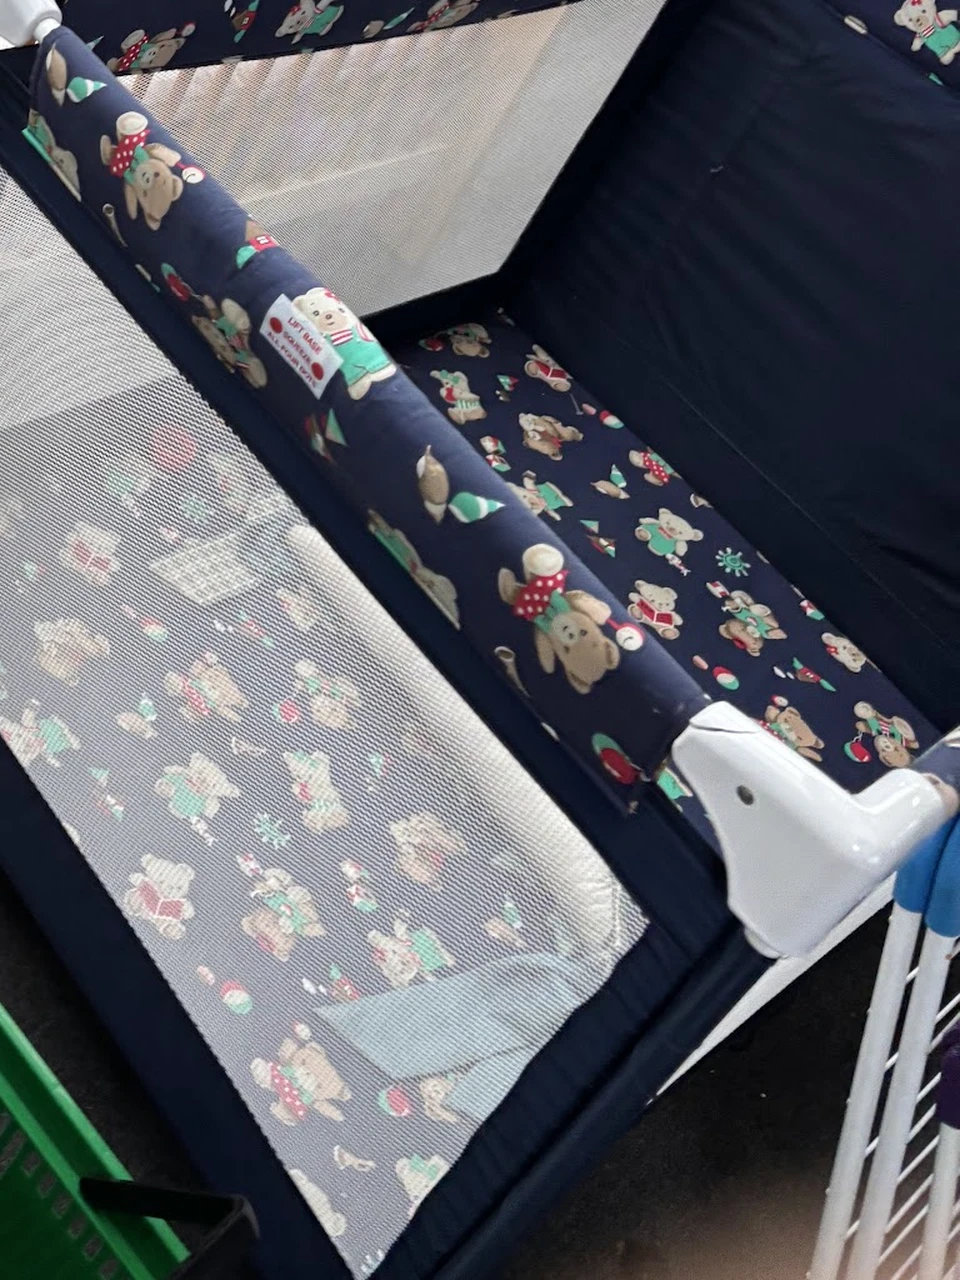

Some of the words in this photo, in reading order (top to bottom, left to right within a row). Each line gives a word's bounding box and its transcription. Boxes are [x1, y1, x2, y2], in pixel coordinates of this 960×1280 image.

[267, 331, 280, 347] ALL
[280, 344, 300, 369] FOUR
[282, 331, 311, 365] SQUEEZE
[287, 316, 304, 333] LIFT
[302, 332, 323, 355] BASE
